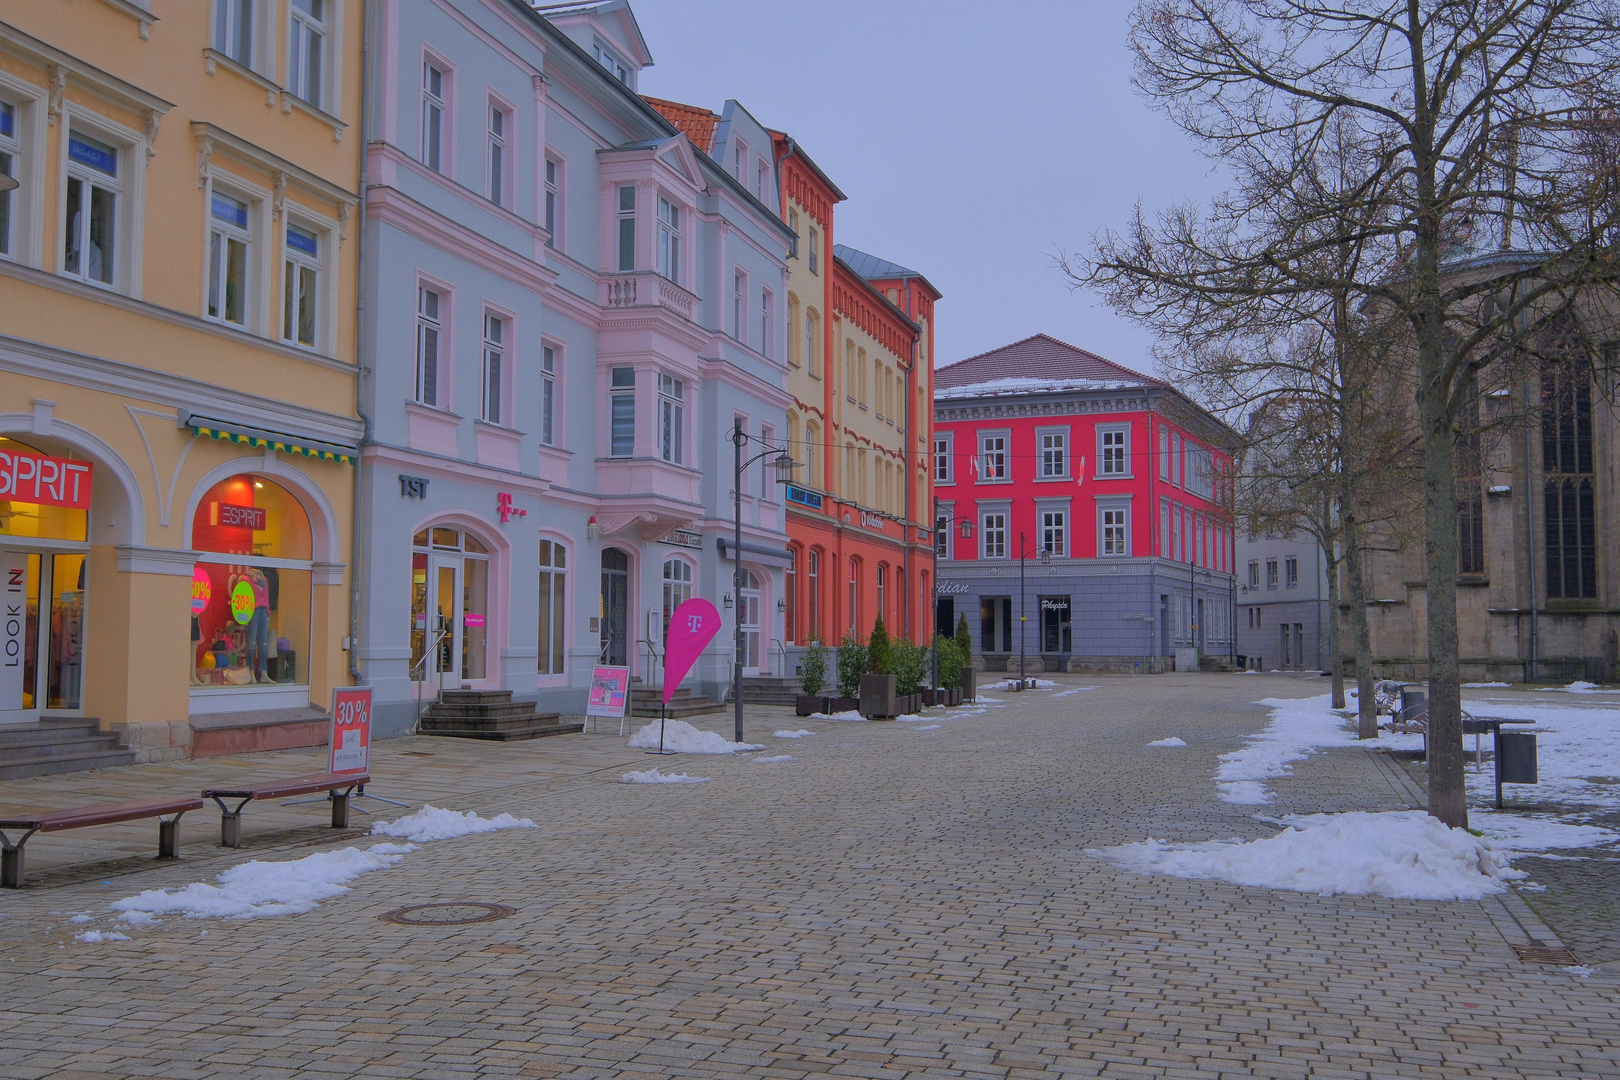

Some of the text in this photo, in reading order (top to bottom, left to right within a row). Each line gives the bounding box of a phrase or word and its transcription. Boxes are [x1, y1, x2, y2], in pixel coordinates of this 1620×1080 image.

[399, 475, 429, 499] TST
[222, 506, 263, 527] ESPRIT
[5, 569, 24, 667] LOOK IN
[688, 614, 703, 633] T
